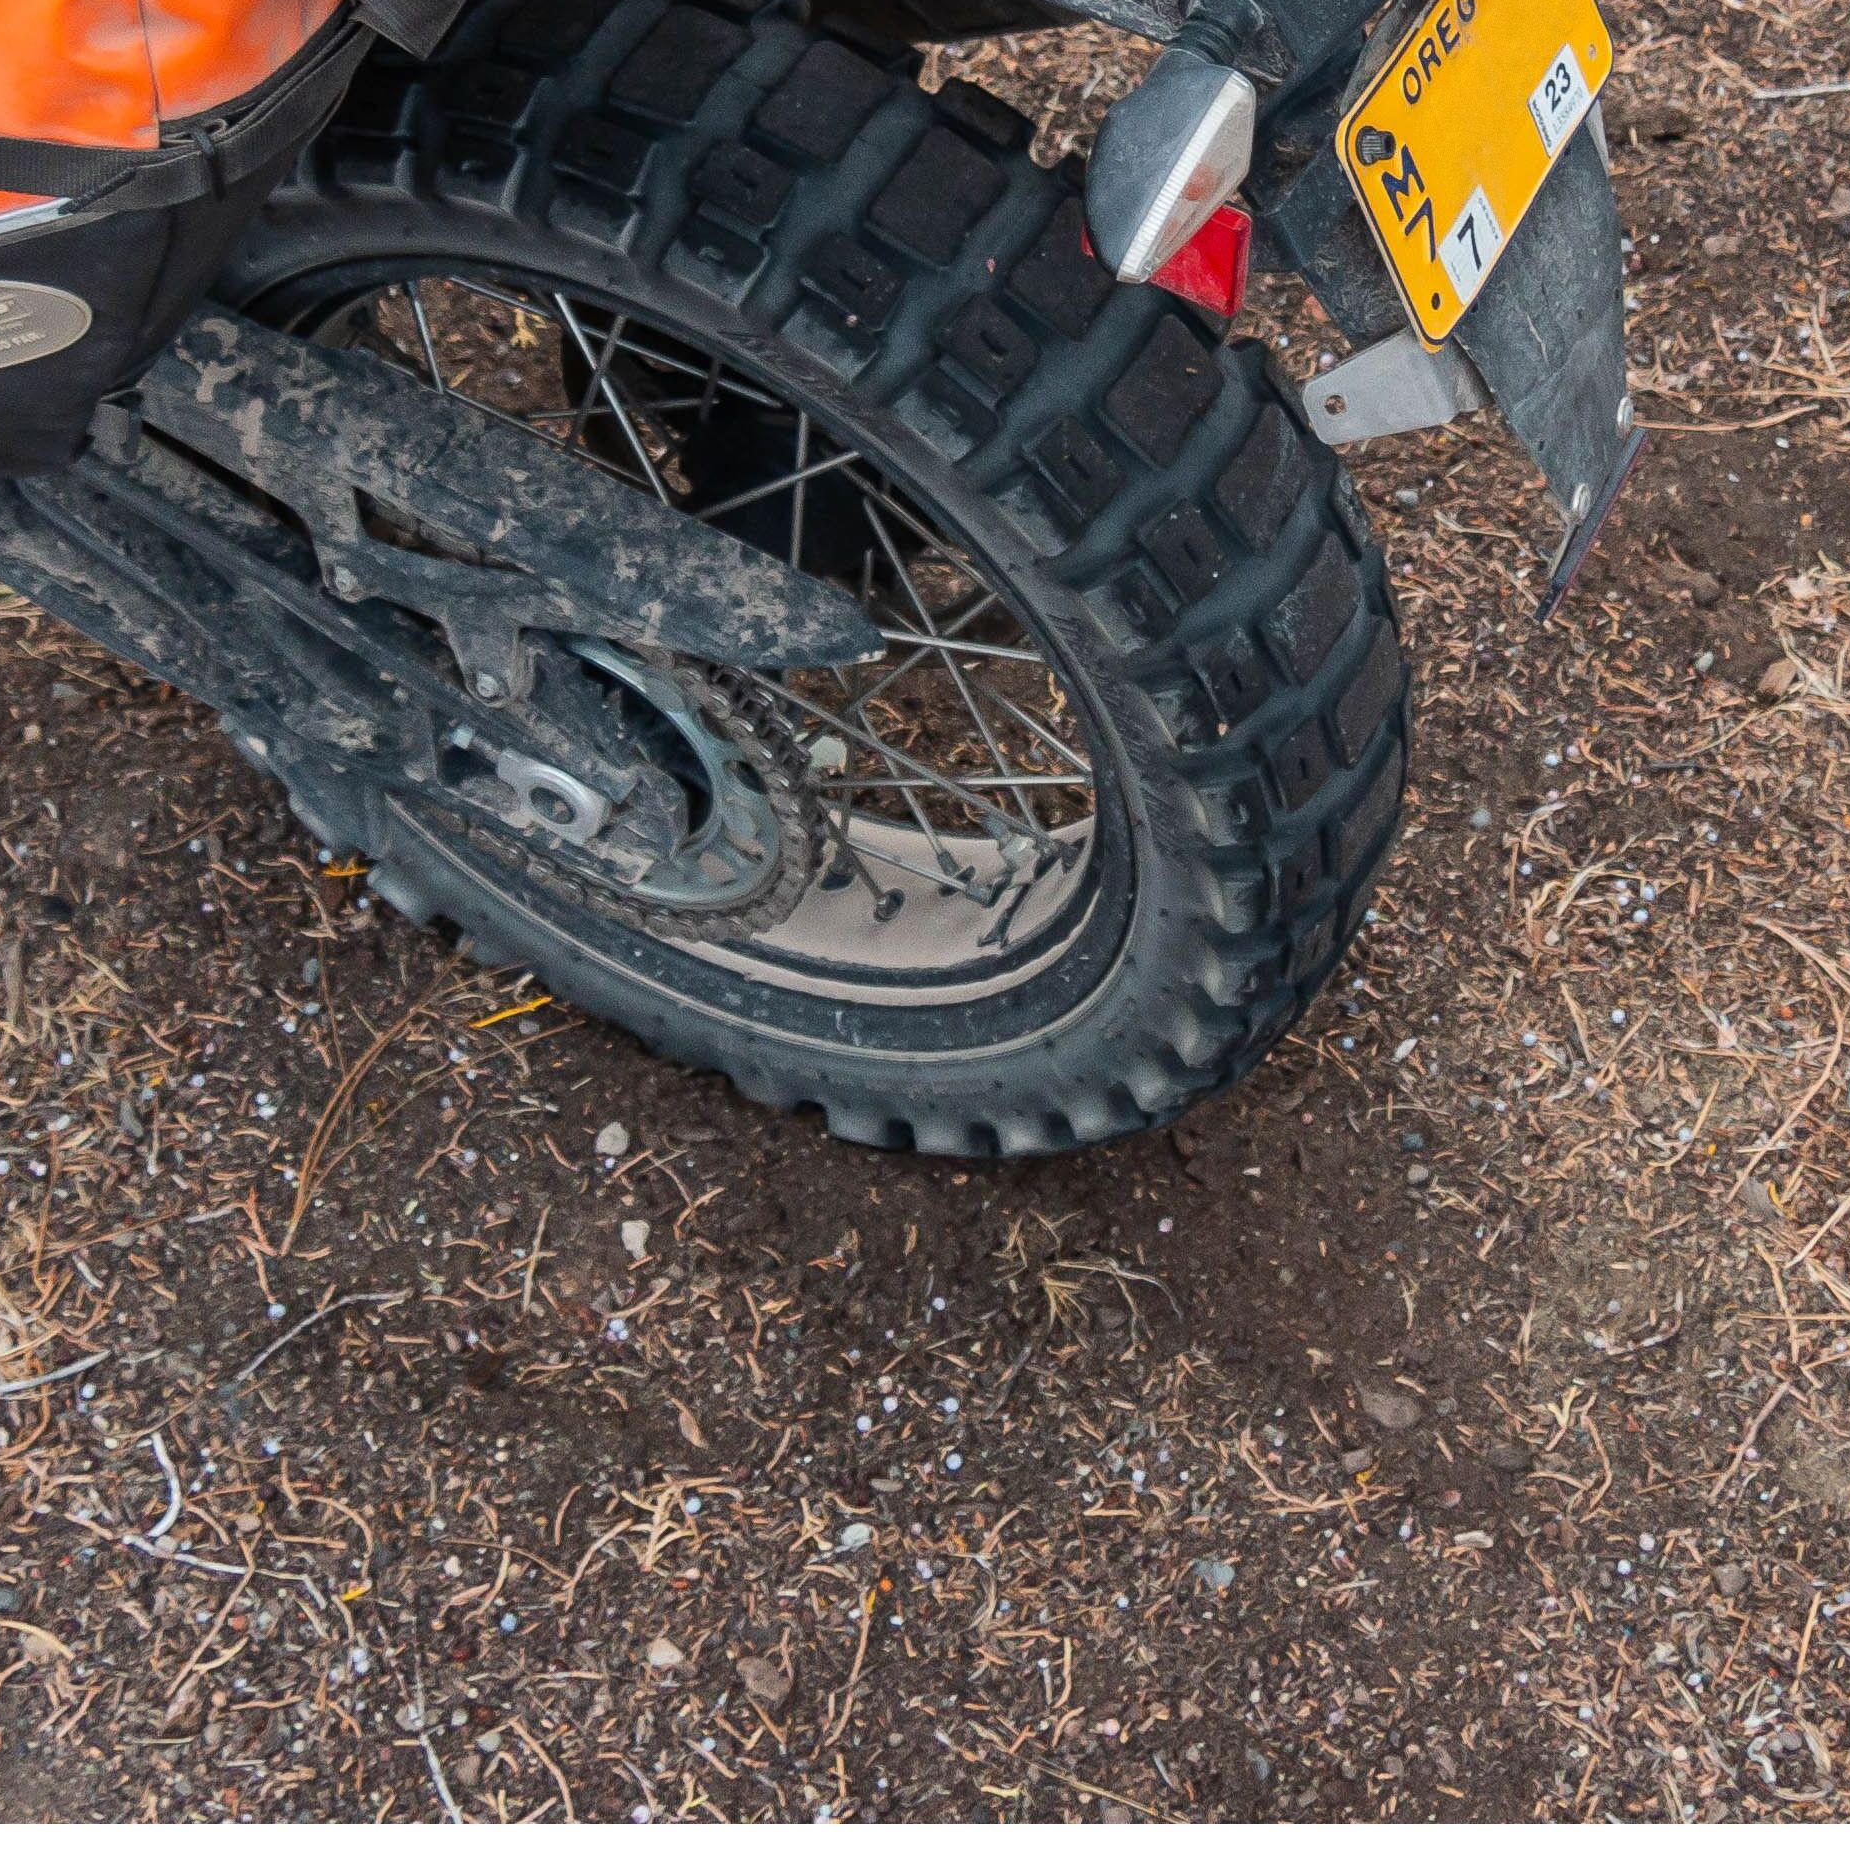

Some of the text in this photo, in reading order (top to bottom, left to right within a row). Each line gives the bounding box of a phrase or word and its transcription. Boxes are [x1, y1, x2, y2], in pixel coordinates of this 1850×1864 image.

[1545, 61, 1571, 113] 23
[1381, 143, 1426, 222] M
[1457, 212, 1482, 272] 7
